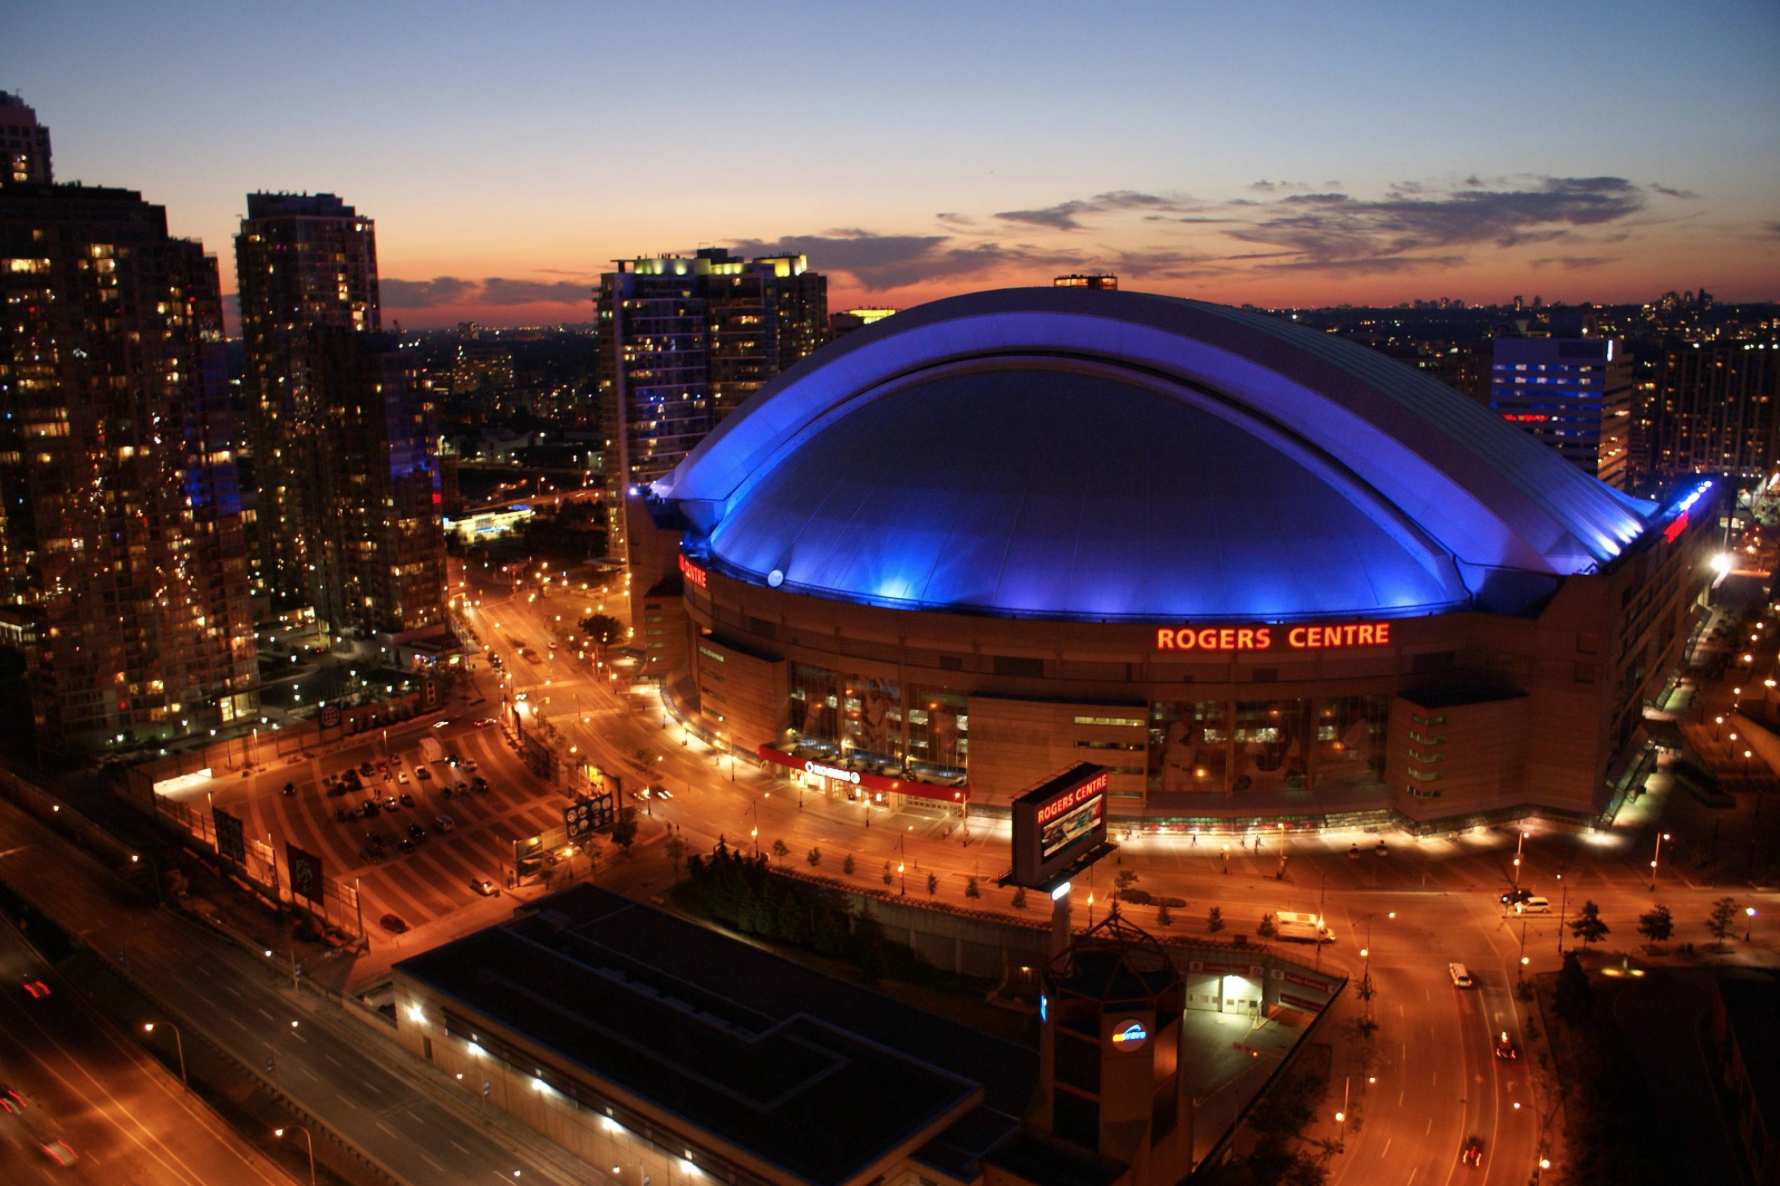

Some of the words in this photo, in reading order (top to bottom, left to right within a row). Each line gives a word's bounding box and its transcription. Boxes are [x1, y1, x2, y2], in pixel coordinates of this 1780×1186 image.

[1157, 628, 1271, 650] ROGERS
[1289, 623, 1390, 648] CENTRE
[1037, 792, 1074, 824] ROGERS
[1075, 774, 1107, 801] CENTRE
